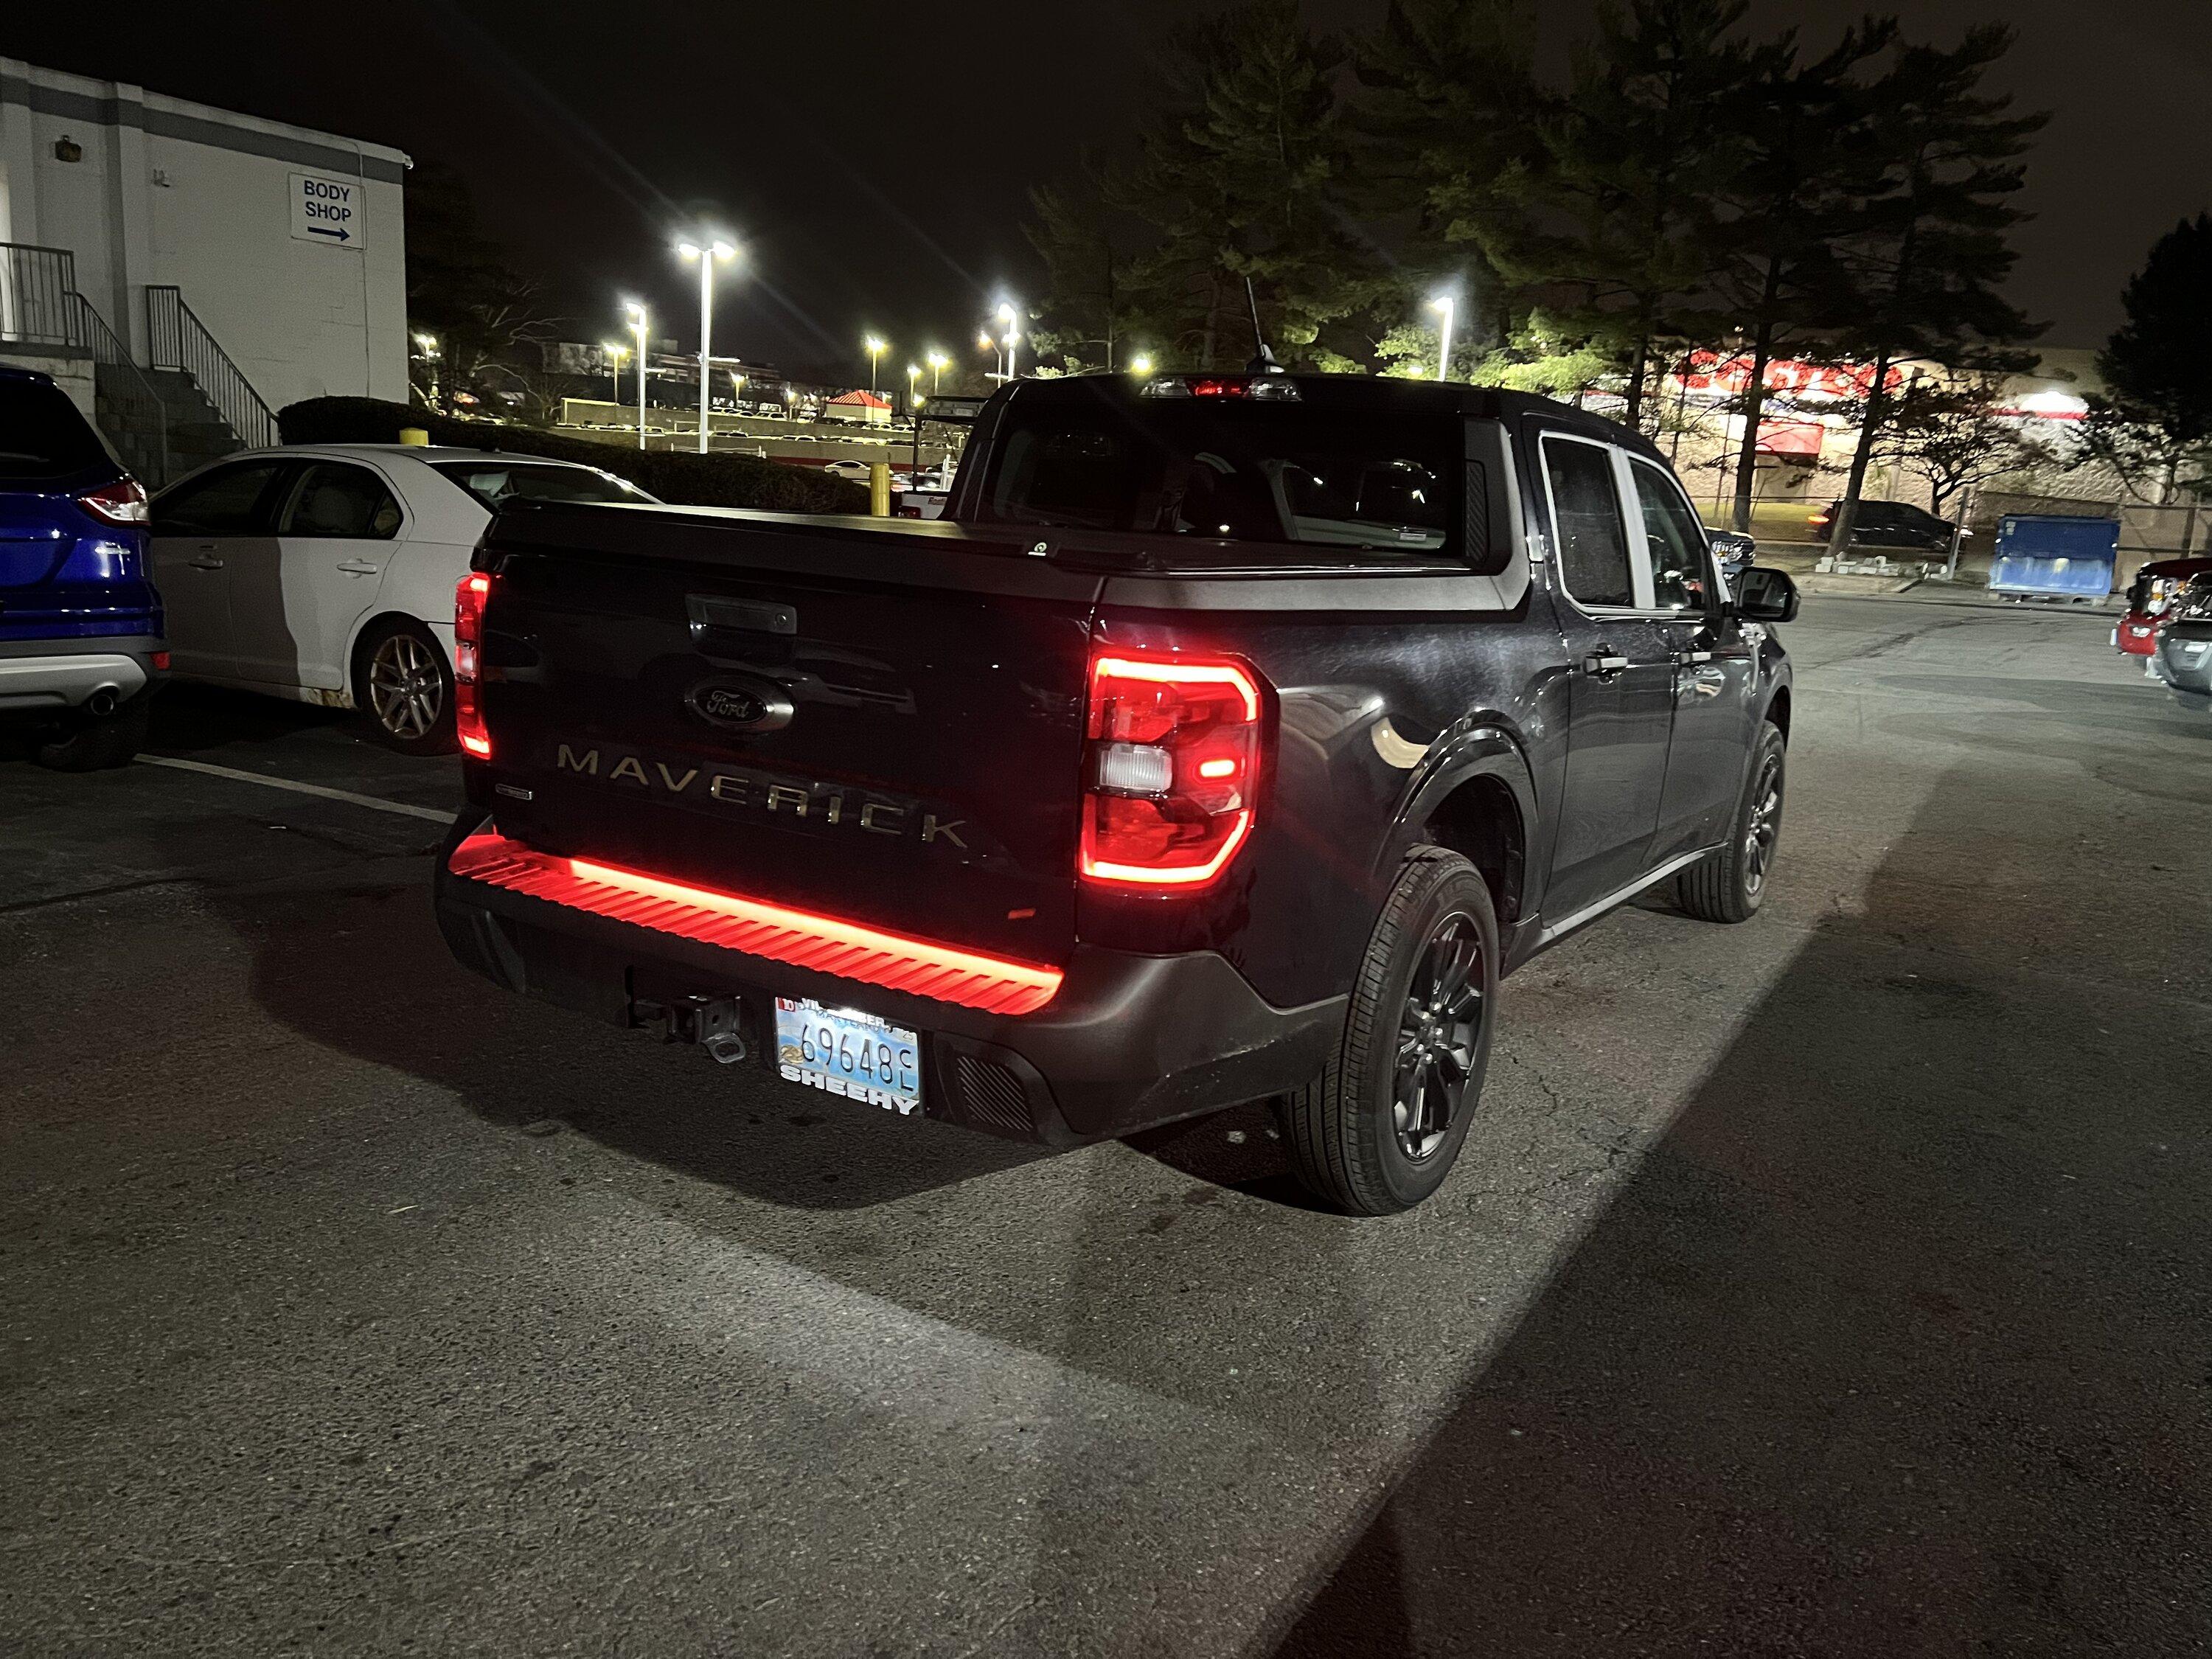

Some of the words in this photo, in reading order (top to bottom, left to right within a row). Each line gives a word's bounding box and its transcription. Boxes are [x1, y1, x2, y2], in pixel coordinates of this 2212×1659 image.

[305, 180, 349, 202] BODY
[305, 201, 352, 222] SHOP
[706, 690, 750, 718] Ford
[557, 743, 968, 849] MAVERICK
[780, 1065, 919, 1116] SHEEHY
